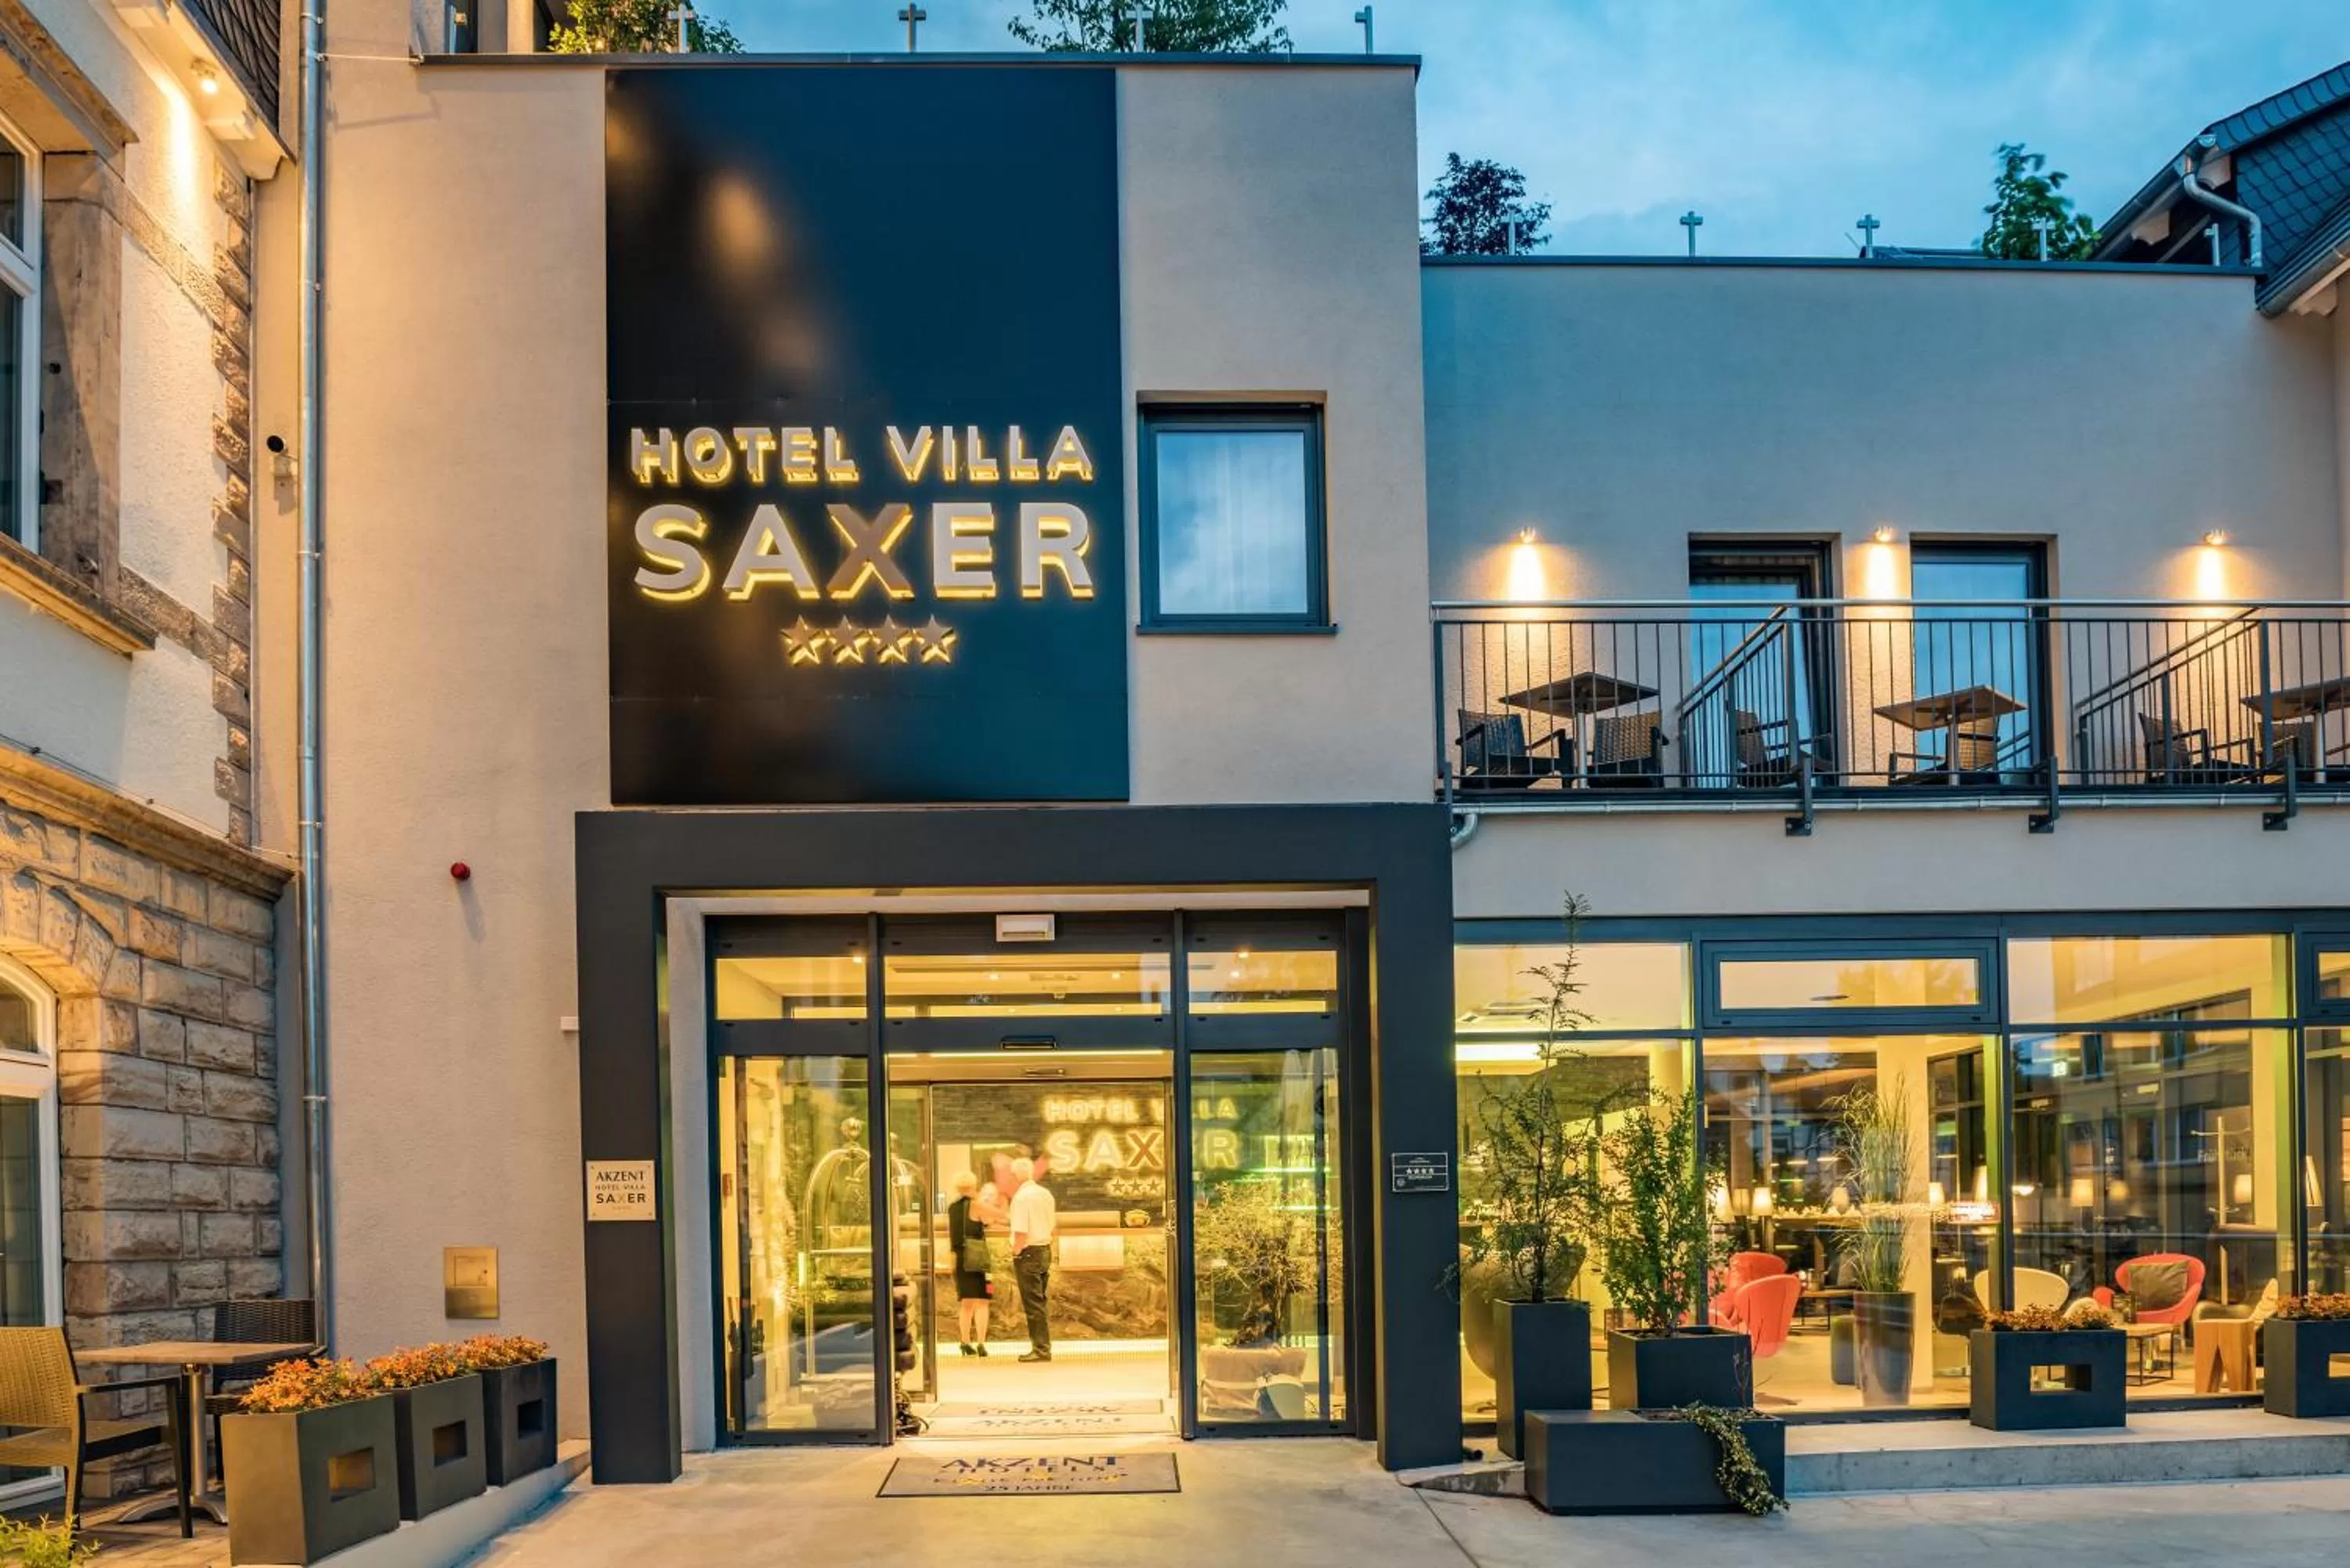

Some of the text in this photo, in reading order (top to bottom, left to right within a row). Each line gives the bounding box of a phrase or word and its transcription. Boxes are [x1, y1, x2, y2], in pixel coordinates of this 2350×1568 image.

[630, 425, 1094, 483] HOTEL VILLA
[634, 502, 1095, 602] SAXER
[1044, 1098, 1139, 1122] HOTEL
[1049, 1129, 1239, 1172] SAXR
[596, 1171, 645, 1182] AKZENT
[596, 1193, 646, 1204] SAXER
[941, 1455, 1126, 1469] AKZENT
